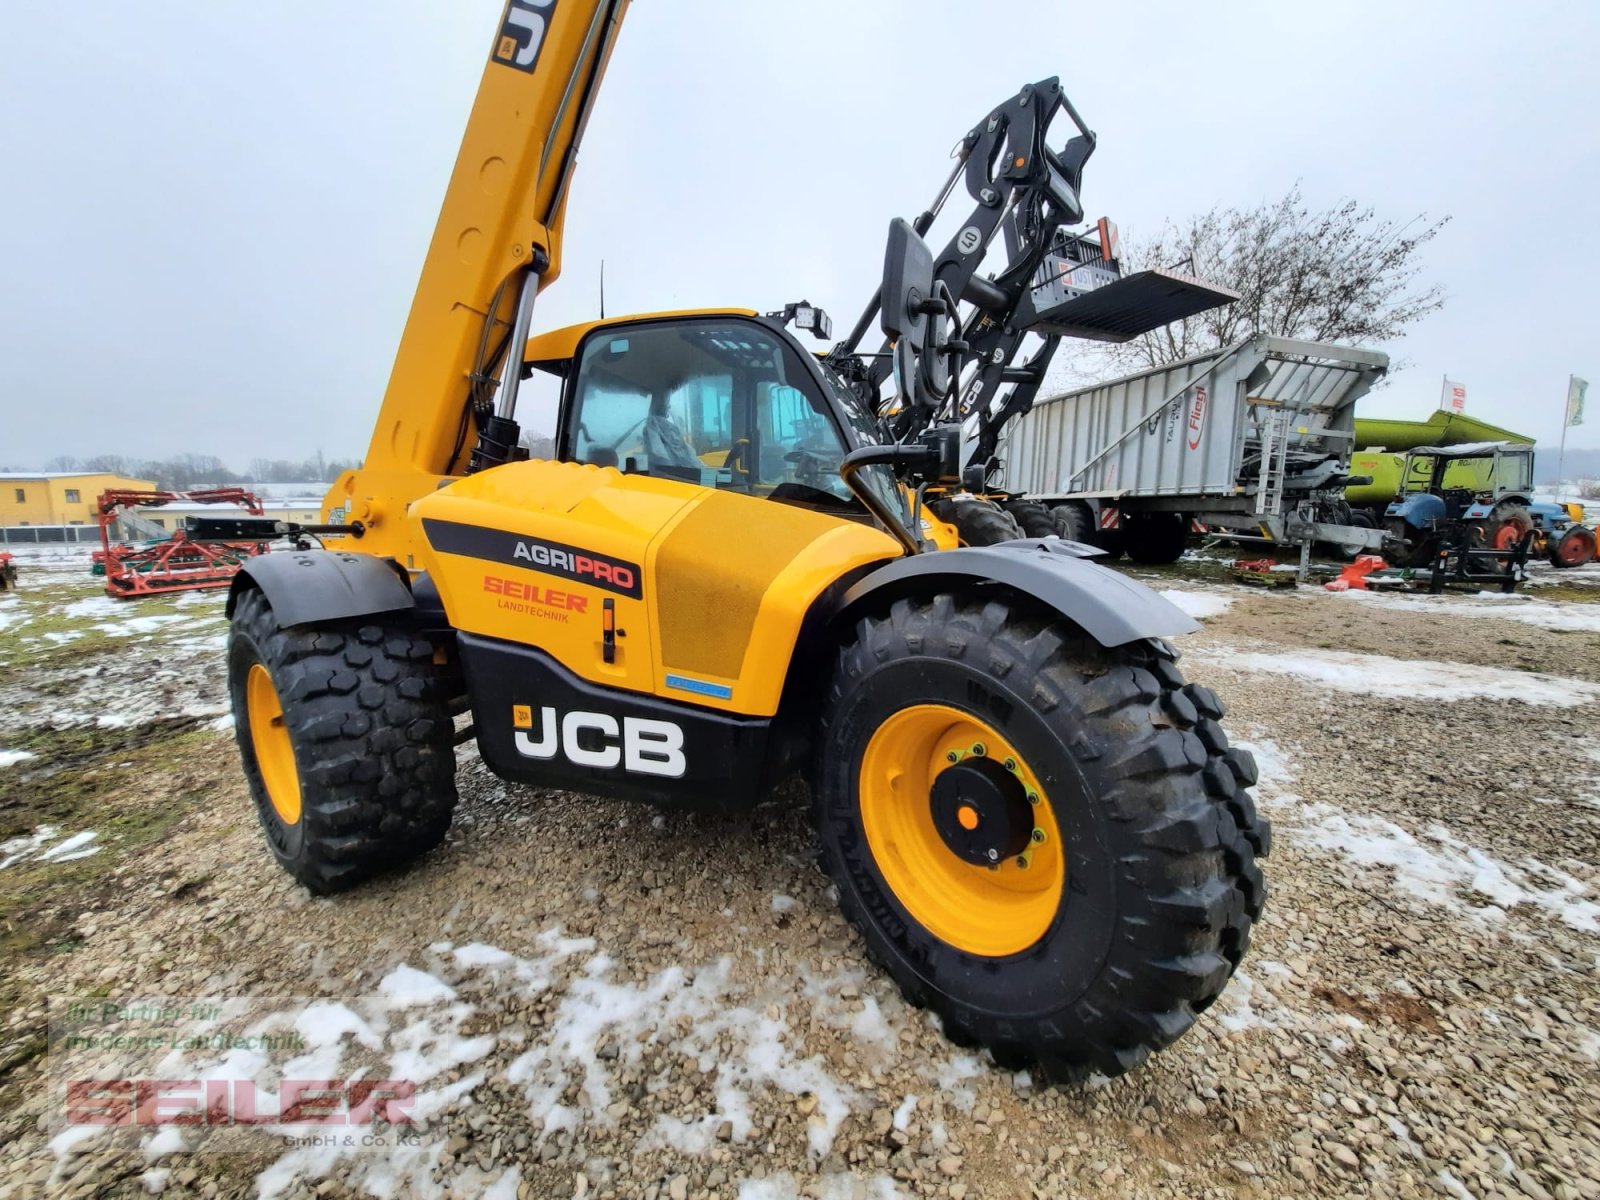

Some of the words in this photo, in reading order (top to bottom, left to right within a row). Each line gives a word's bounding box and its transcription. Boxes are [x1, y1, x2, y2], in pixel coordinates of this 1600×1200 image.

[507, 0, 554, 66] J
[961, 231, 978, 249] 40
[965, 380, 984, 414] JCB
[1189, 386, 1207, 430] Fliegl
[513, 541, 634, 589] AGRIPRO
[484, 576, 588, 613] SEILER
[497, 600, 569, 624] LANDTECHNIK
[513, 706, 686, 777] JCB
